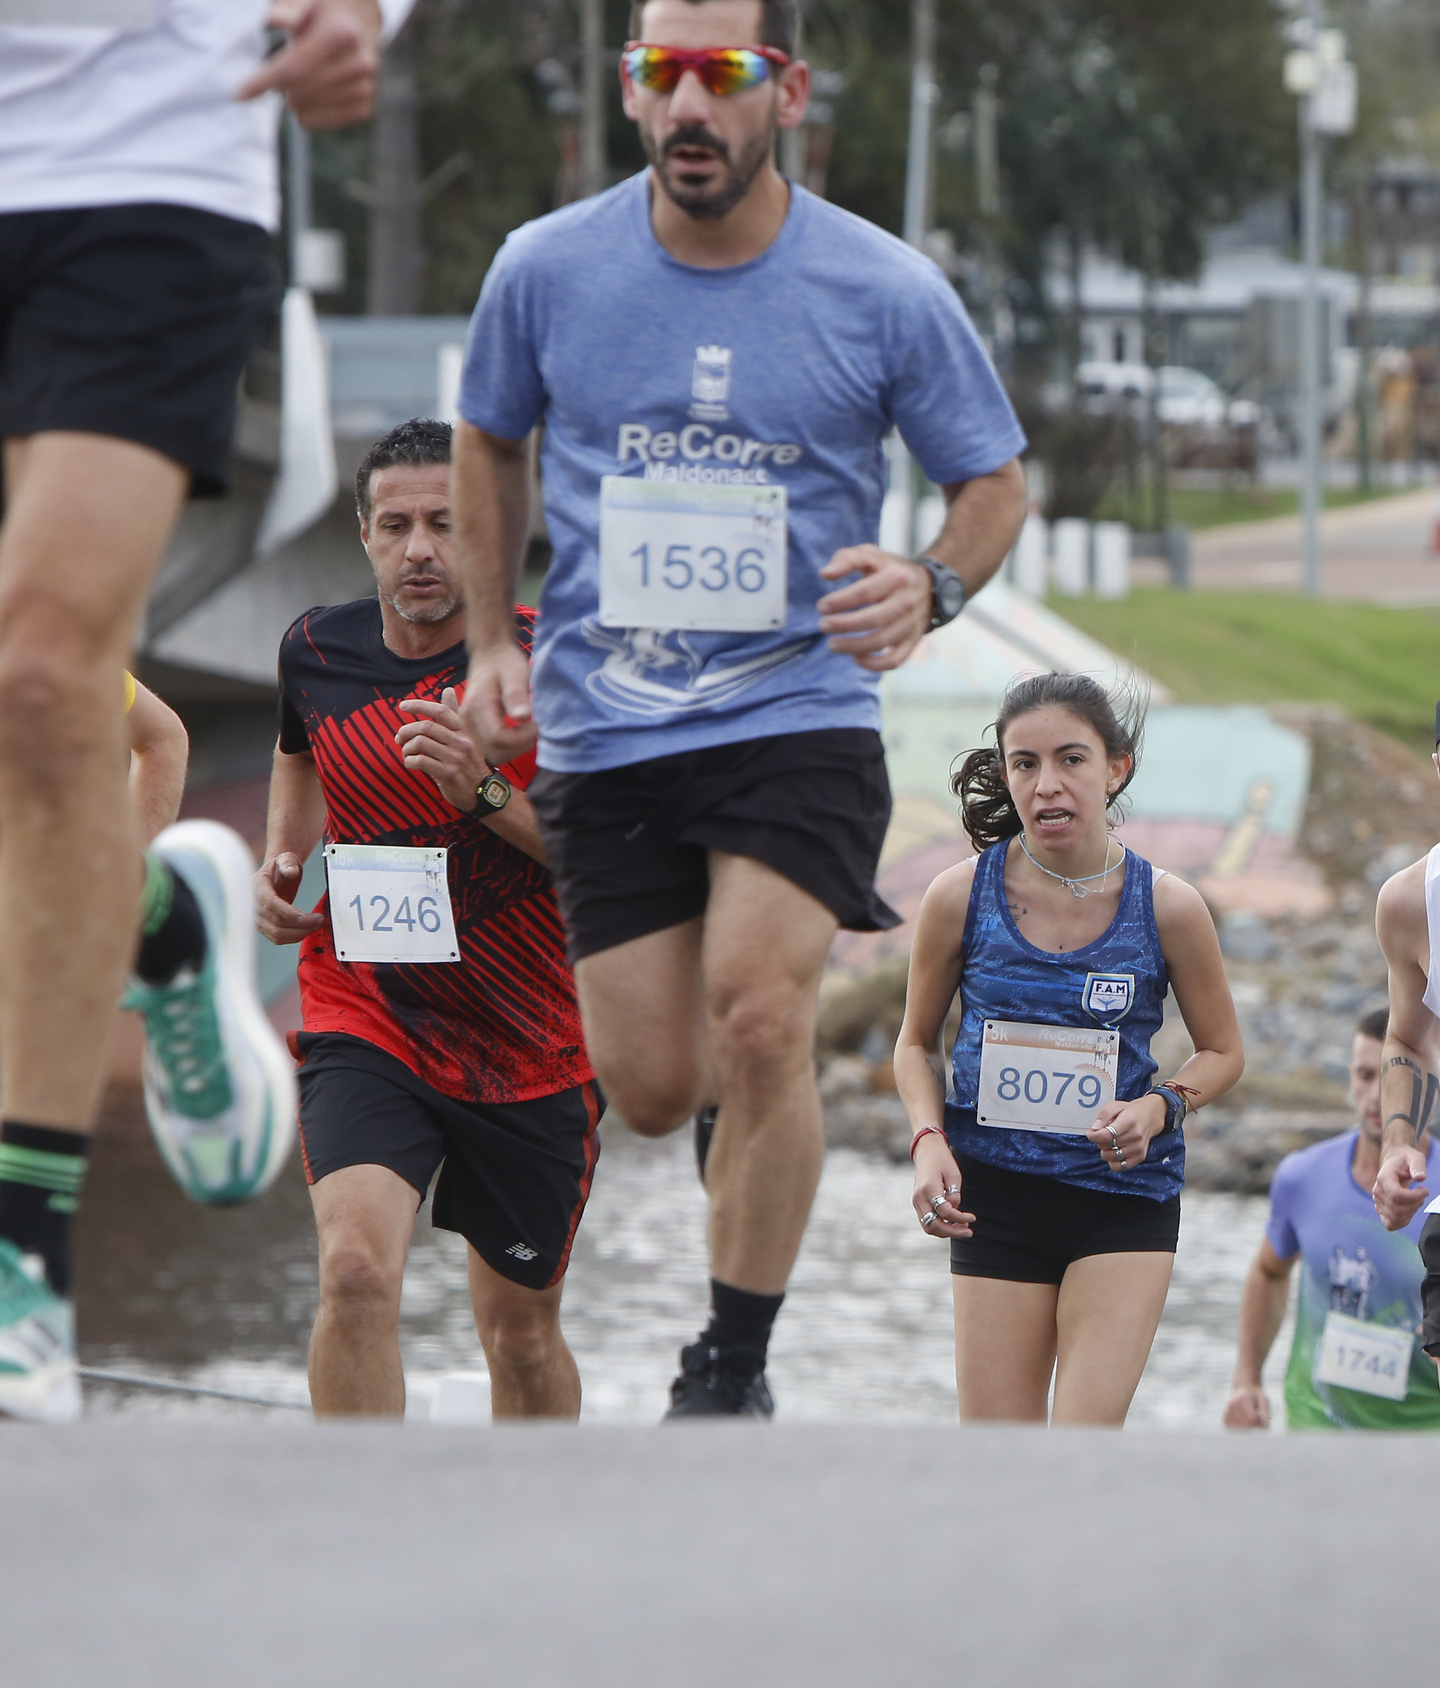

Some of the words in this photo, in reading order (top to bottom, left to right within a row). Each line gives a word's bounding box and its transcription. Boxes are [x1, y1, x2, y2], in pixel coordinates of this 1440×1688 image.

[617, 423, 801, 465] ReCorre
[630, 542, 766, 593] 1536
[349, 894, 441, 932] 1246
[1095, 982, 1126, 994] F.A.M
[1039, 1028, 1095, 1045] ReCorre
[1054, 1041, 1093, 1050] Maldonado
[996, 1067, 1101, 1109] 8079
[1337, 1347, 1397, 1380] 1744
